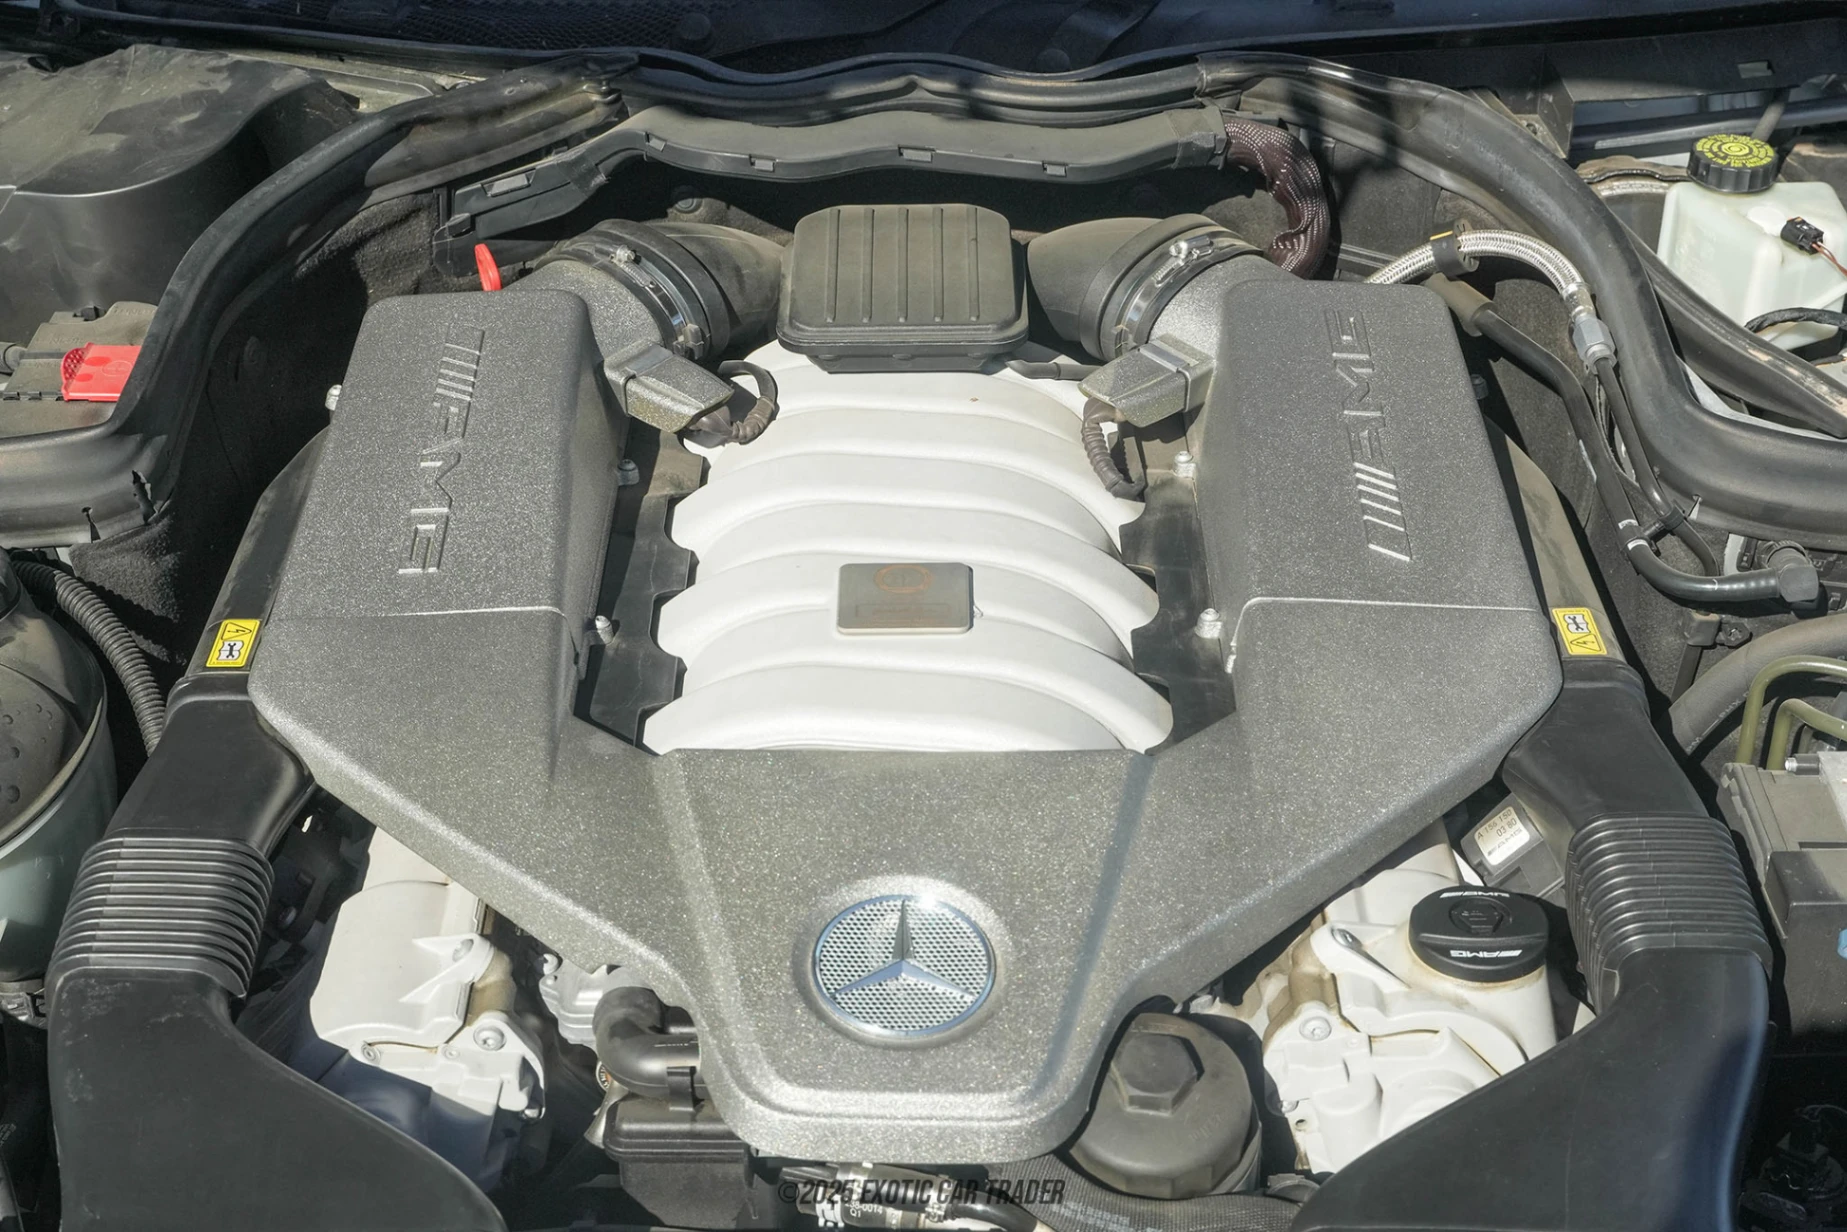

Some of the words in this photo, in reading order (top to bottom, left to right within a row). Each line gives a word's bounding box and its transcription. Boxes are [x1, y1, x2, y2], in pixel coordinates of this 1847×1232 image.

[1477, 831, 1484, 840] A
[1485, 820, 1498, 834] 156
[1499, 808, 1512, 822] 150
[1496, 825, 1507, 837] 03
[1507, 817, 1517, 829] 80
[844, 1201, 883, 1215] 38-0014
